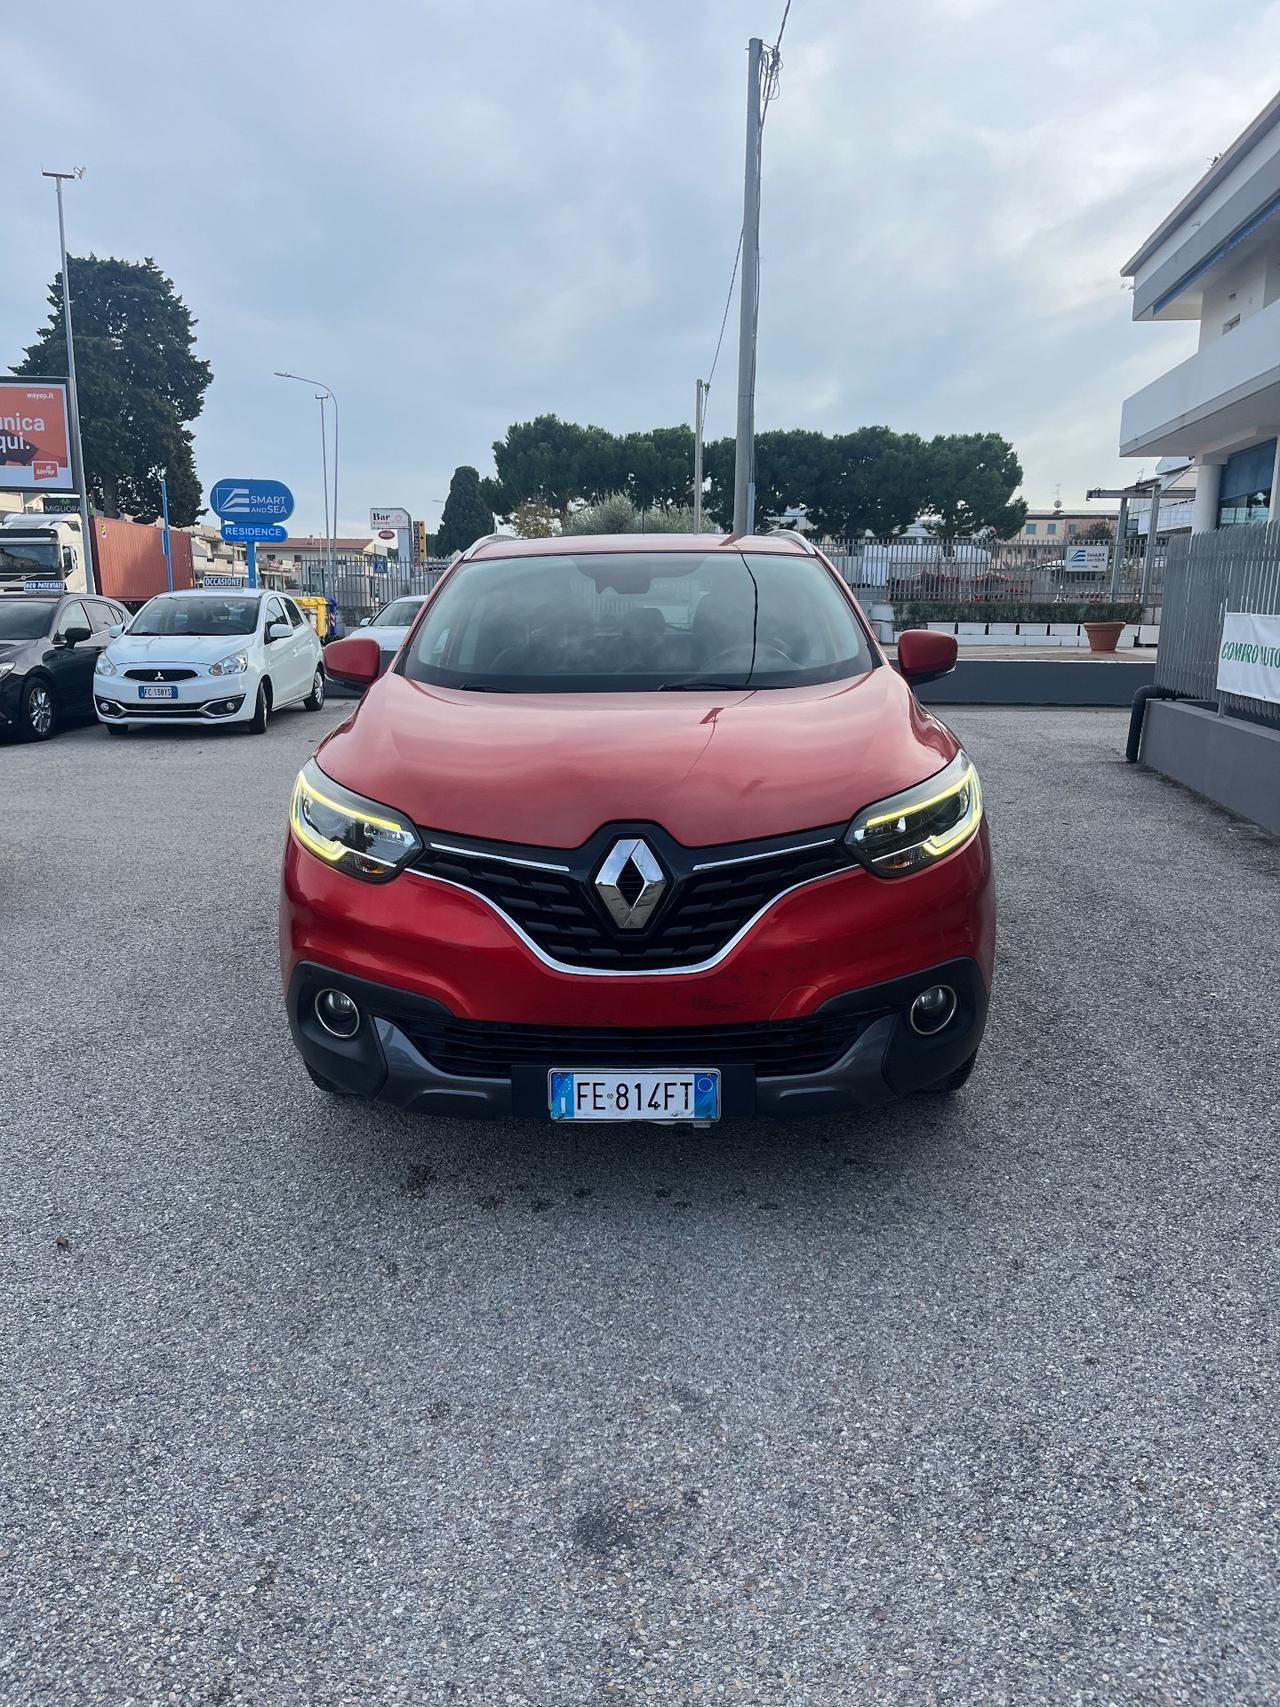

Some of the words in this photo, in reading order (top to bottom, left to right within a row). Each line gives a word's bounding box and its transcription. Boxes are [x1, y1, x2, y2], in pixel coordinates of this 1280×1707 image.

[0, 412, 45, 431] nica
[250, 495, 287, 505] SMART
[373, 512, 391, 521] Bar
[225, 527, 282, 536] RESIDENCE
